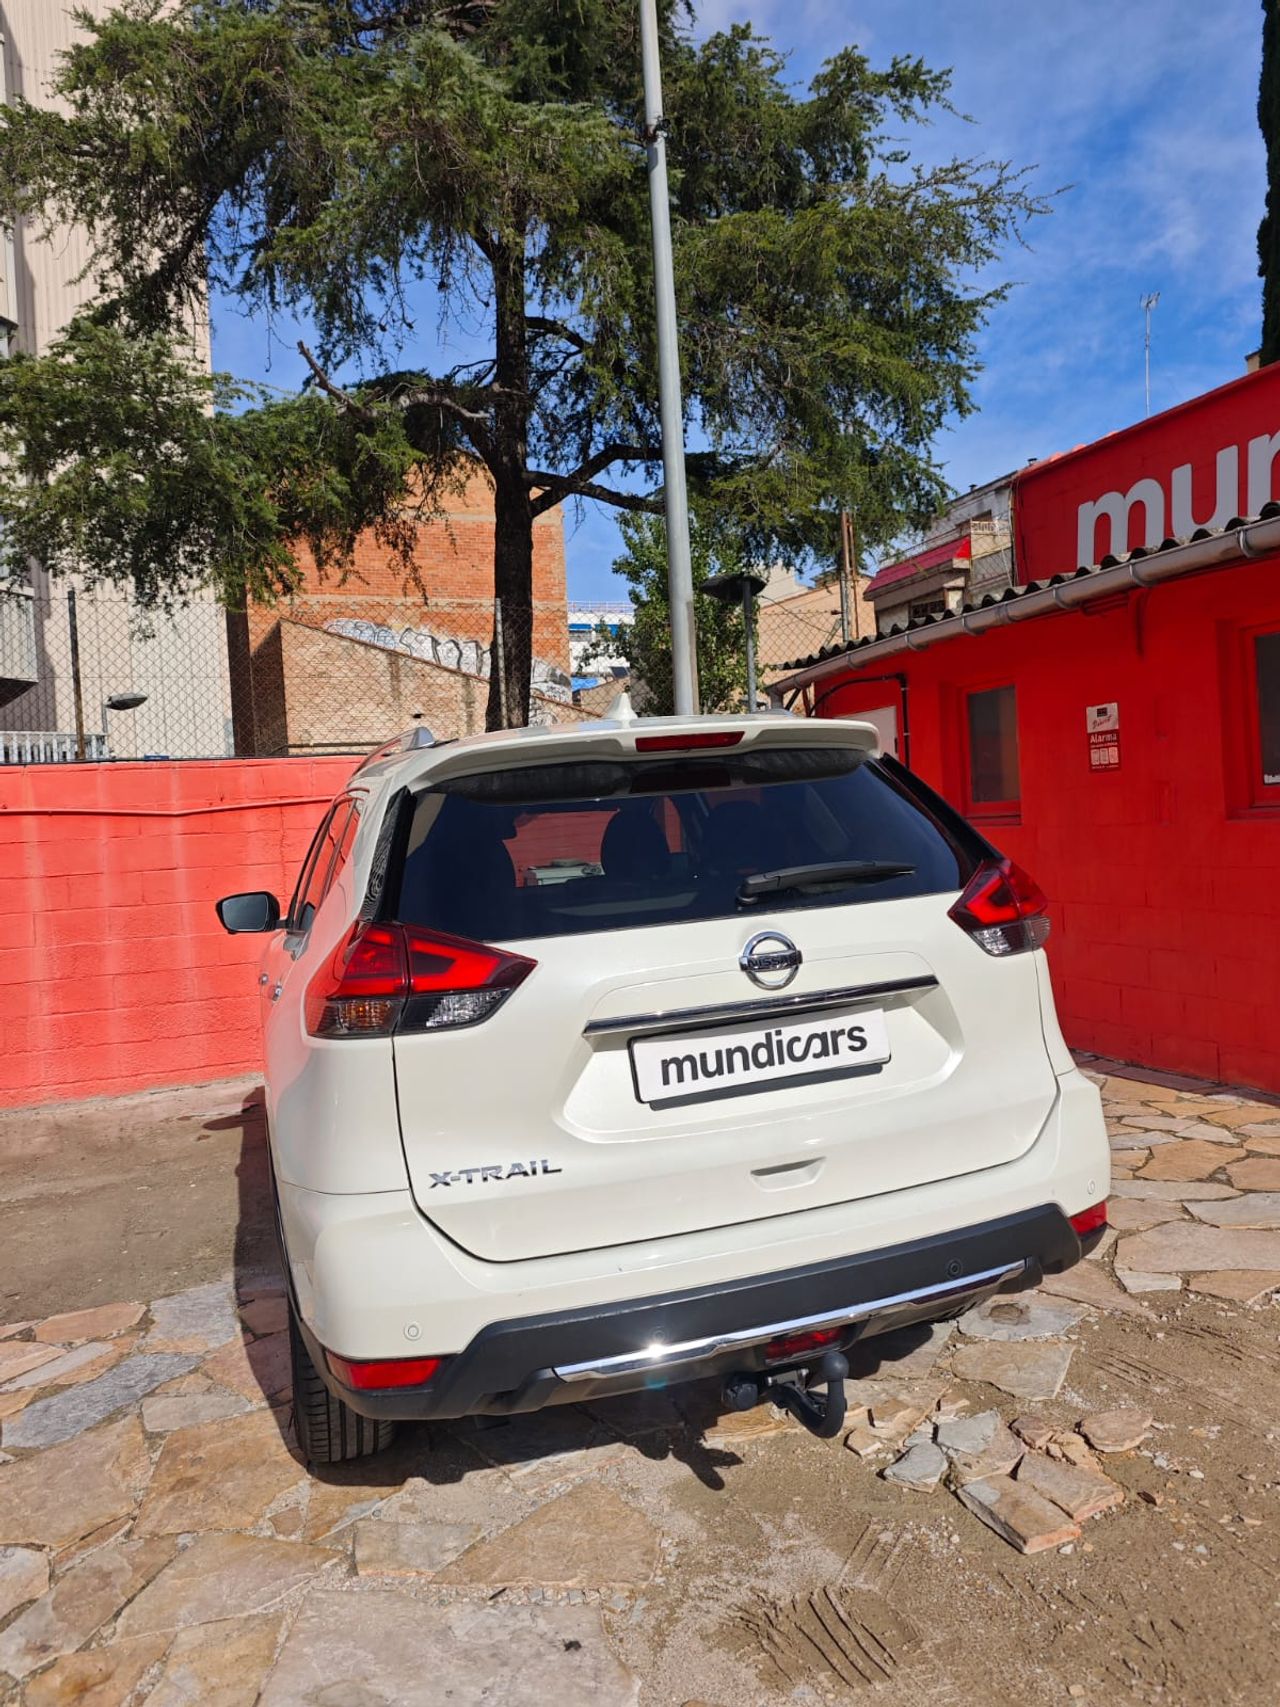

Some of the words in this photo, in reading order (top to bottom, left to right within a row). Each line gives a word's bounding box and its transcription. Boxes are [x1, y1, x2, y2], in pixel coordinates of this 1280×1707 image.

[1090, 733, 1117, 744] Alarma
[660, 1026, 868, 1086] mundicars
[429, 1159, 562, 1188] X-TRAIL
